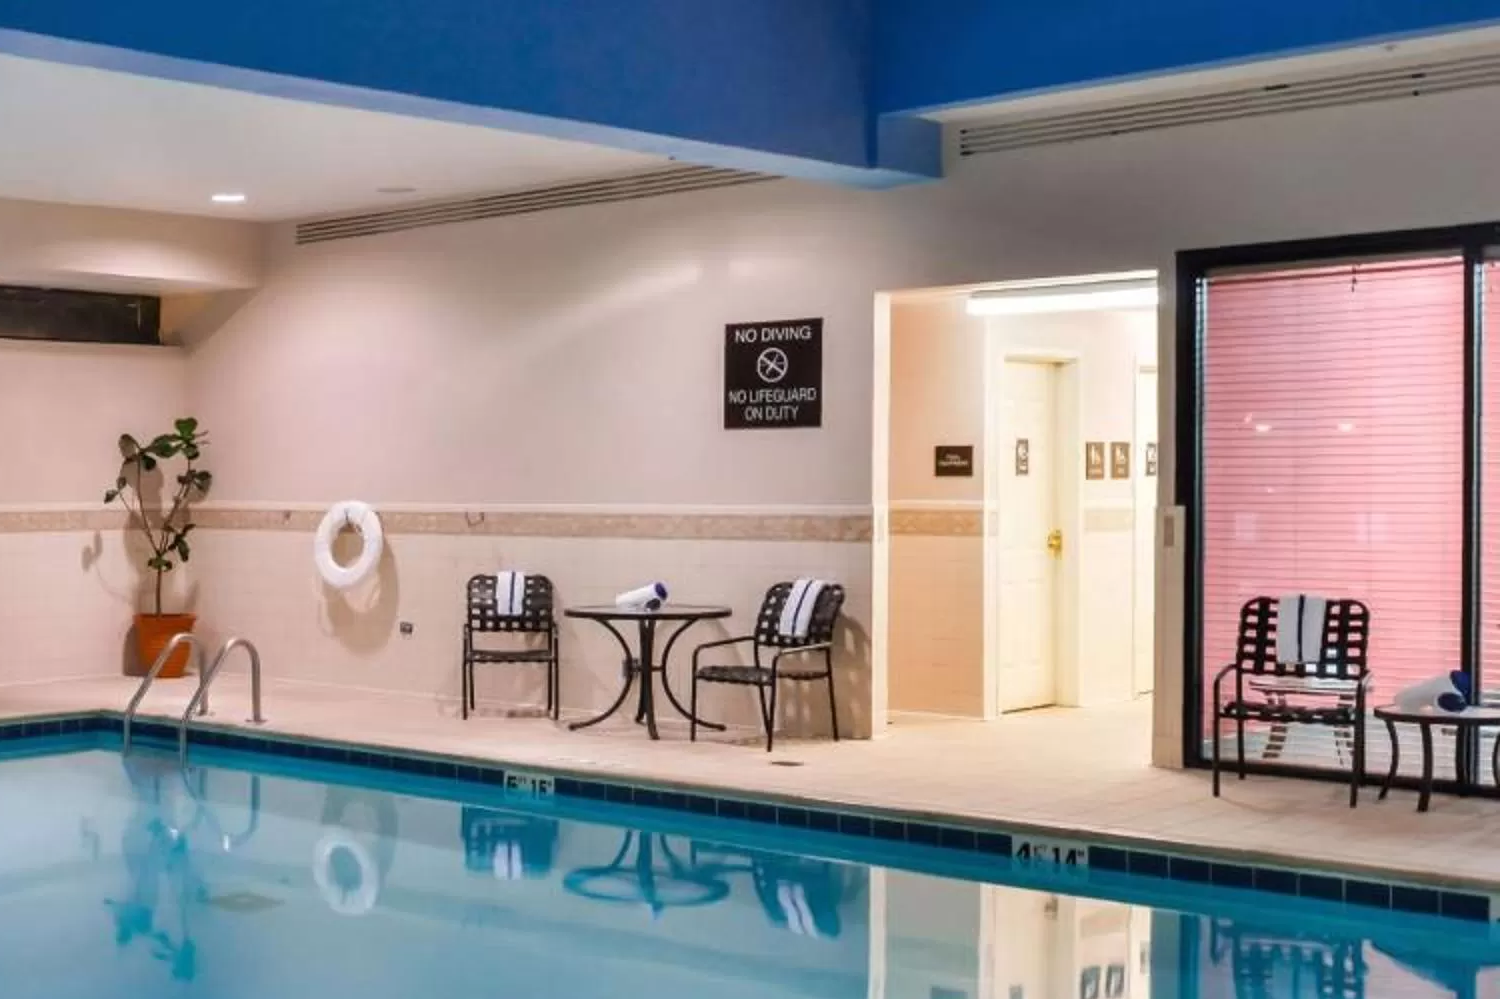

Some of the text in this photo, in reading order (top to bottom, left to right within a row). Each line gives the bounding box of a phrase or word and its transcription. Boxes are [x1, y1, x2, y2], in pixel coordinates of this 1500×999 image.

[735, 325, 812, 343] NO DIVING
[729, 387, 817, 404] NO LIFEGUARD
[745, 405, 799, 420] ON DUTY
